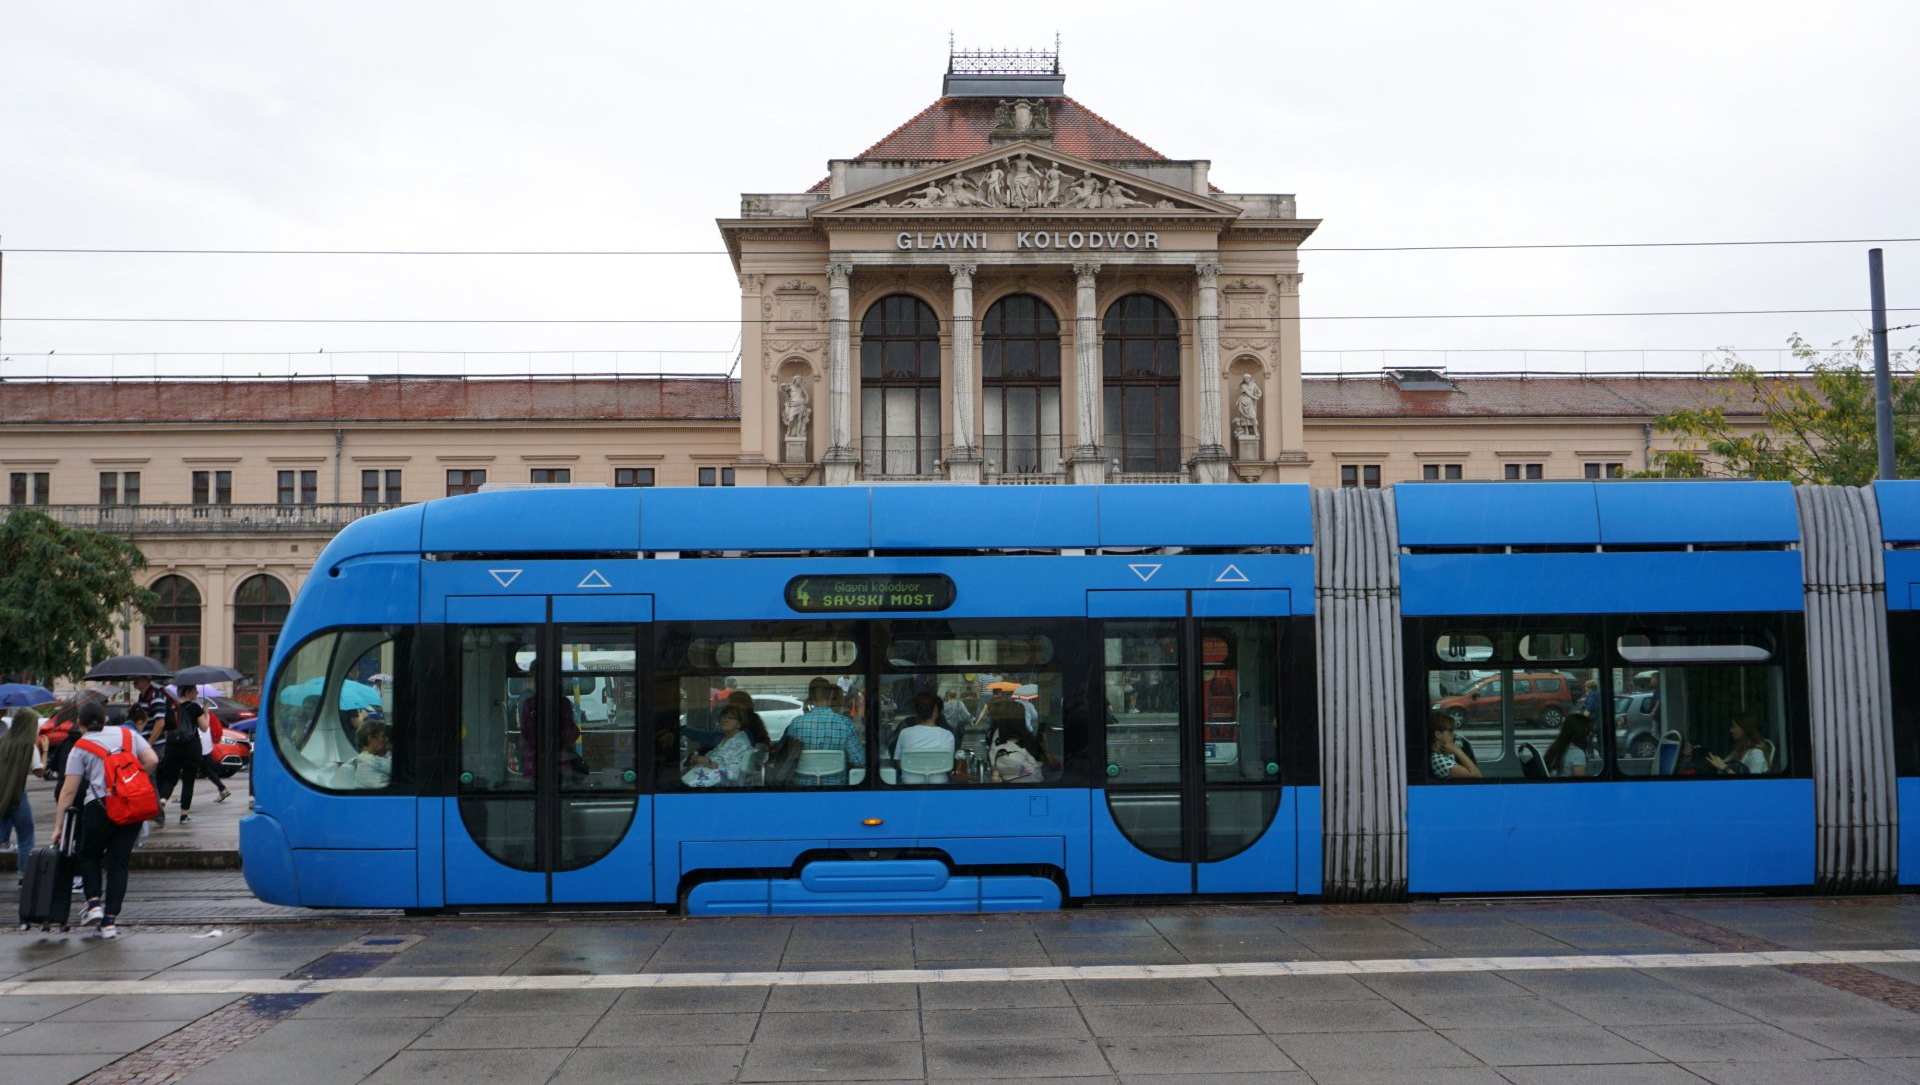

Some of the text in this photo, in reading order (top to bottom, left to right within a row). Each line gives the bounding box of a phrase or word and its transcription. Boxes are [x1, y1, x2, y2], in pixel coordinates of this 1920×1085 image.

[896, 231, 1159, 249] GLAVNI KOLODVOR
[797, 579, 809, 606] 4
[834, 581, 921, 593] Glavni kolodvor
[823, 594, 935, 606] SAVSKI MOST
